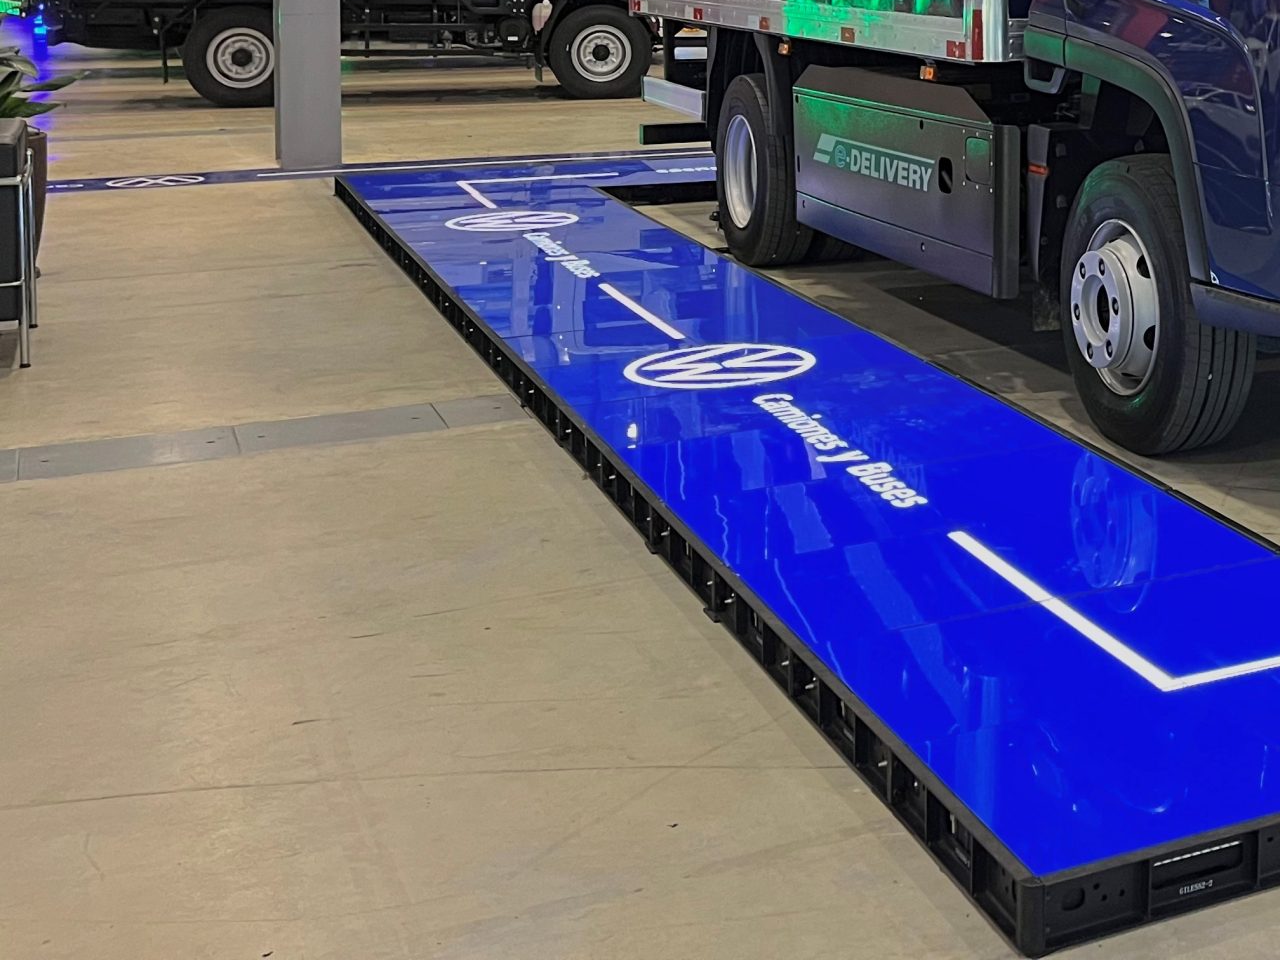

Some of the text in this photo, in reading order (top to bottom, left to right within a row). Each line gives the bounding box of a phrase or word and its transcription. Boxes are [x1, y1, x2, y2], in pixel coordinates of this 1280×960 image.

[834, 145, 933, 192] e-DELIVERY
[752, 393, 929, 509] Camiones y Buses
